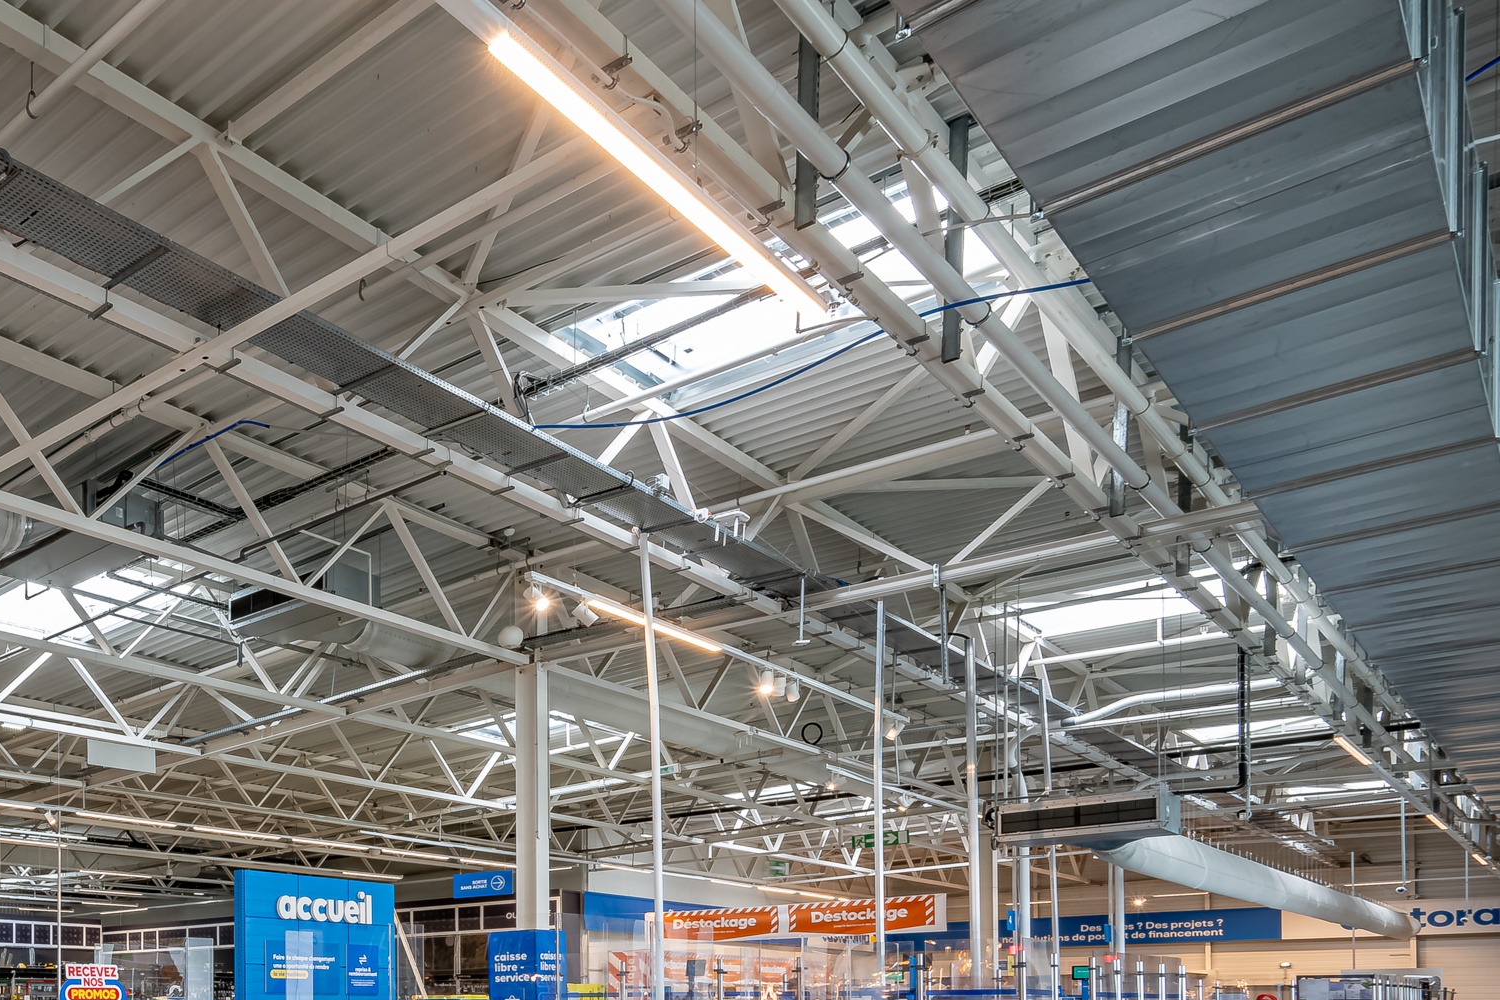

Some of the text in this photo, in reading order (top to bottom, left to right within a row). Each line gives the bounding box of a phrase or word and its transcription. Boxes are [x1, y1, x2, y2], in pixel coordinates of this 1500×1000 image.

[276, 890, 373, 925] accueil
[810, 907, 909, 923] Déstockge
[672, 916, 757, 931] Déstockage
[1080, 918, 1224, 933] Des ? Des projets ?
[1071, 933, 1086, 942] de
[1130, 929, 1146, 939] de
[1148, 928, 1224, 938] financement
[309, 955, 336, 963] changement
[494, 951, 528, 962] caisse
[67, 966, 117, 978] RECEVEZ
[494, 963, 518, 972] libre
[83, 977, 104, 987] NOS
[494, 972, 531, 983] service
[71, 988, 117, 1000] PROMOS
